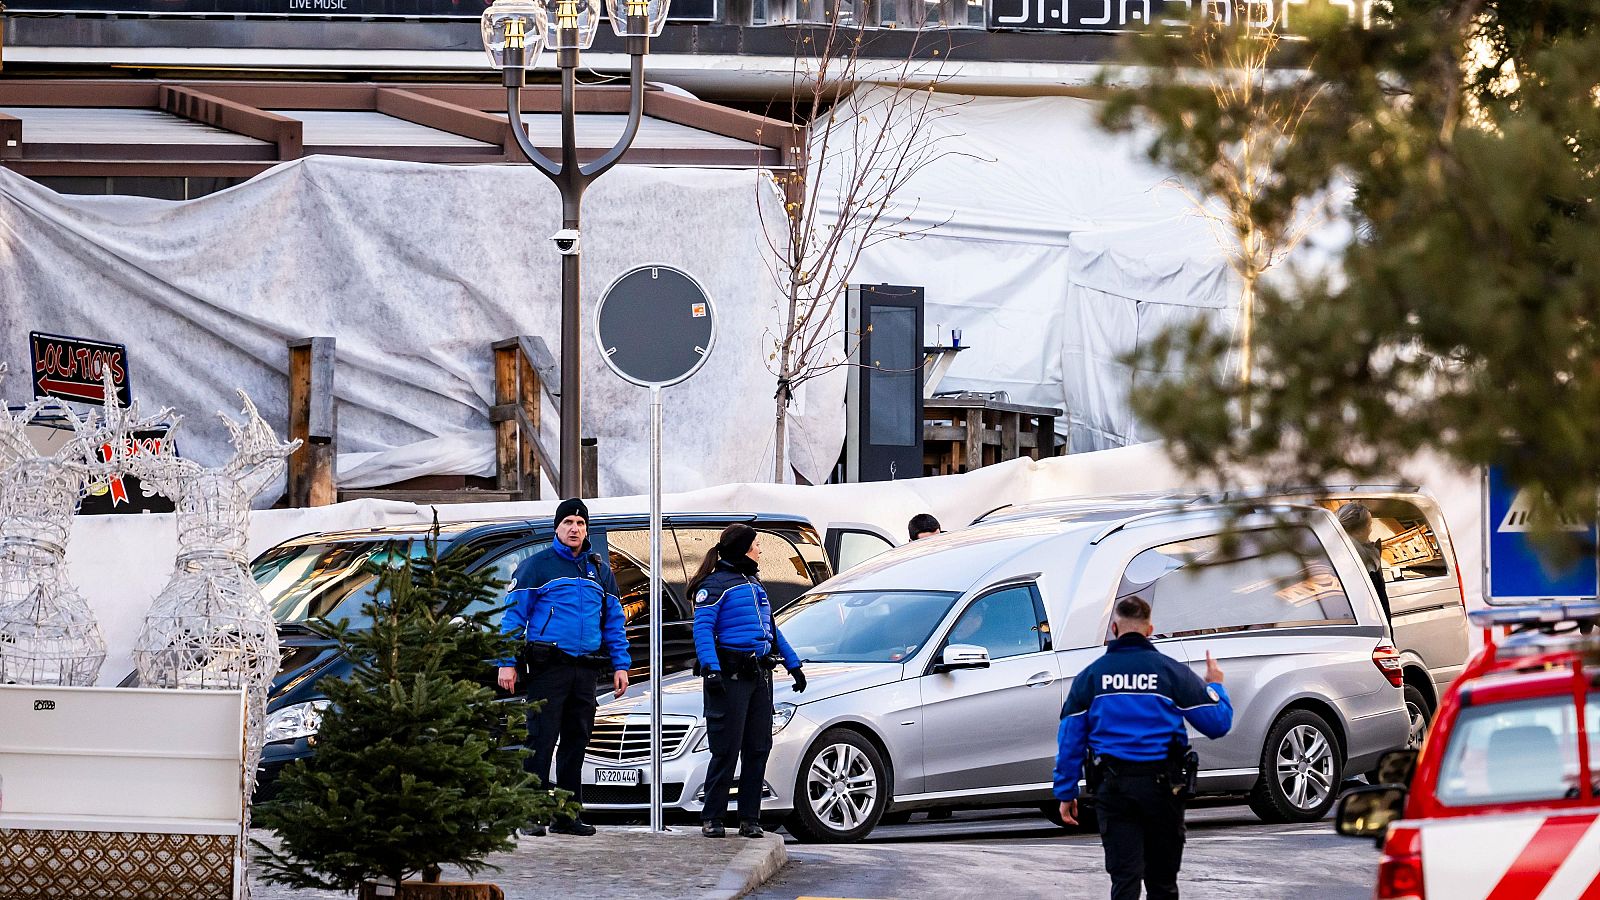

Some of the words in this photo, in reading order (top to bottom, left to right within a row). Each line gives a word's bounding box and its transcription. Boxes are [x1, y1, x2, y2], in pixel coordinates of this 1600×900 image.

[289, 0, 312, 9] LIVE
[314, 0, 348, 9] MUSIC
[34, 340, 125, 384] LOCATIONS
[1101, 673, 1158, 690] POLICE
